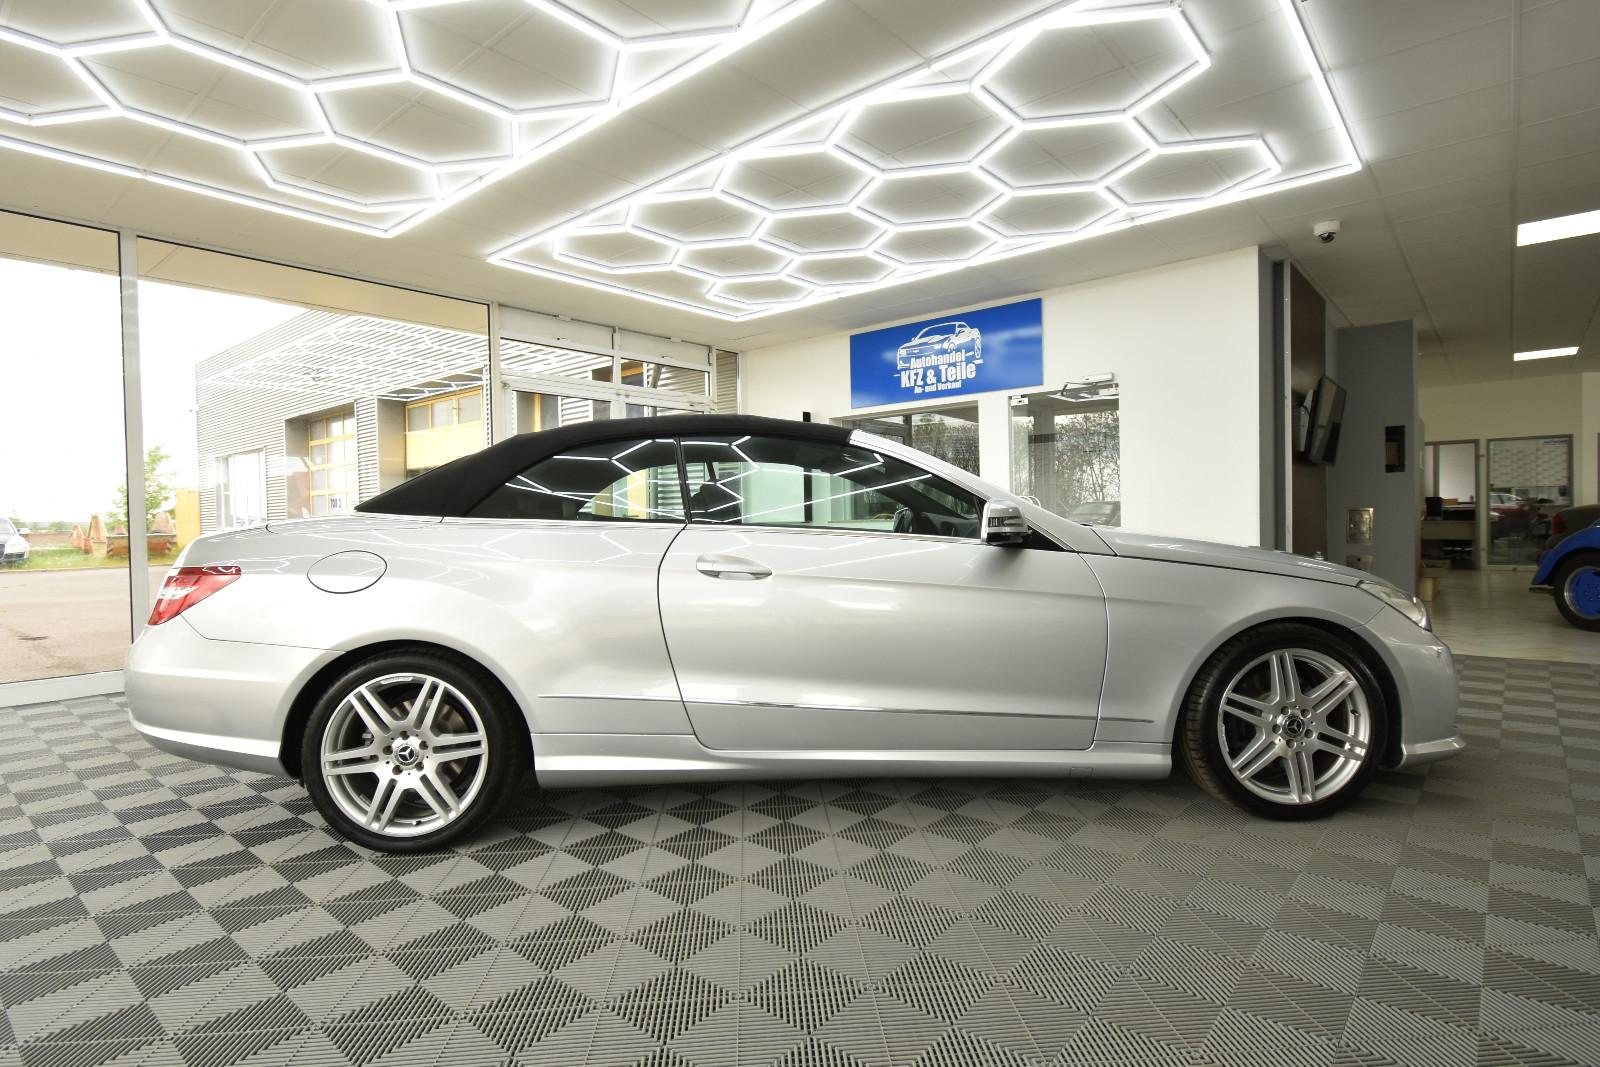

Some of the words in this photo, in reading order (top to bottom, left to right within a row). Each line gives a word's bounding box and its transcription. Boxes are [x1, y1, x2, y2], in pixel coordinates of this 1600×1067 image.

[910, 349, 965, 369] Autohandel
[901, 368, 923, 388] KFZ
[926, 369, 937, 385] &
[939, 362, 976, 383] Teile
[925, 384, 937, 392] und
[937, 380, 962, 391] Verkauf
